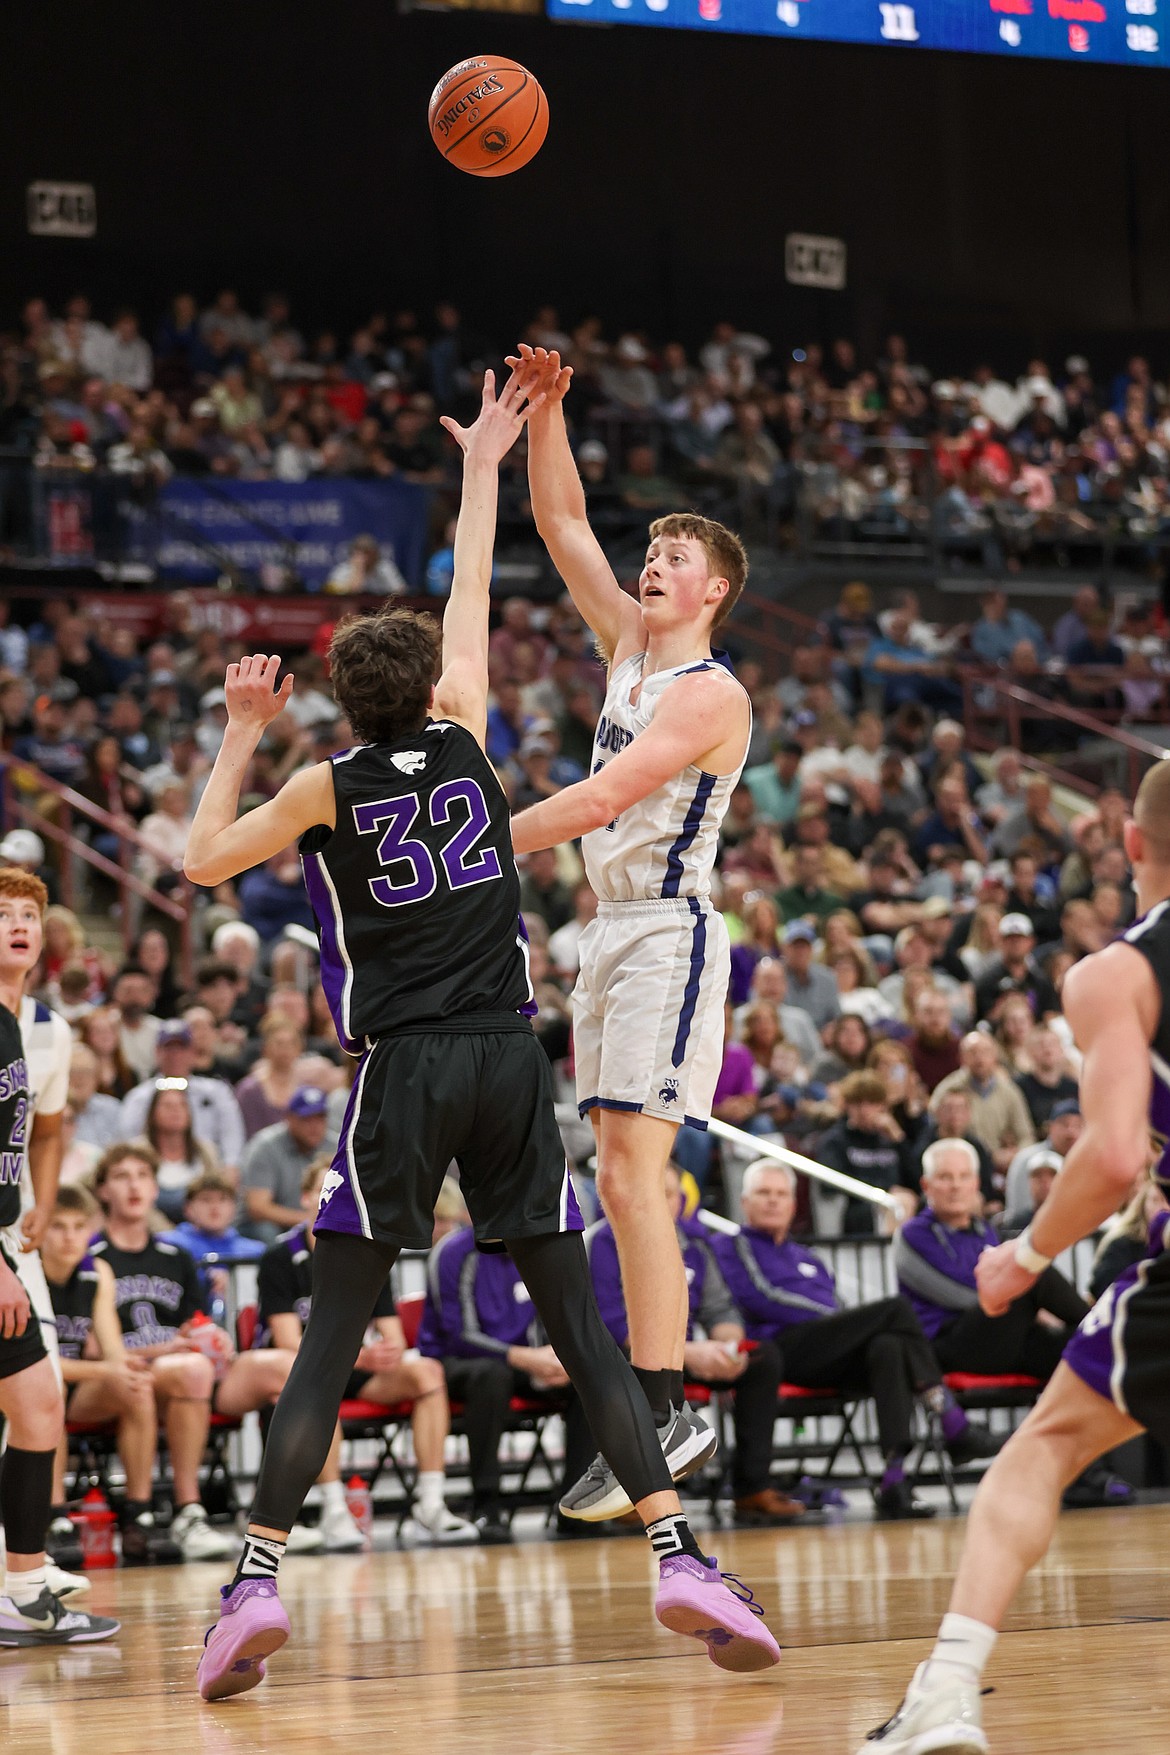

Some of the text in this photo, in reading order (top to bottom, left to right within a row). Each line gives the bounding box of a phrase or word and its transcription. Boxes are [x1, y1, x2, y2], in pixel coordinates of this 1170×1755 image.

[437, 74, 504, 137] SPALDING
[352, 777, 503, 908] 32
[115, 1273, 184, 1311] NAKE
